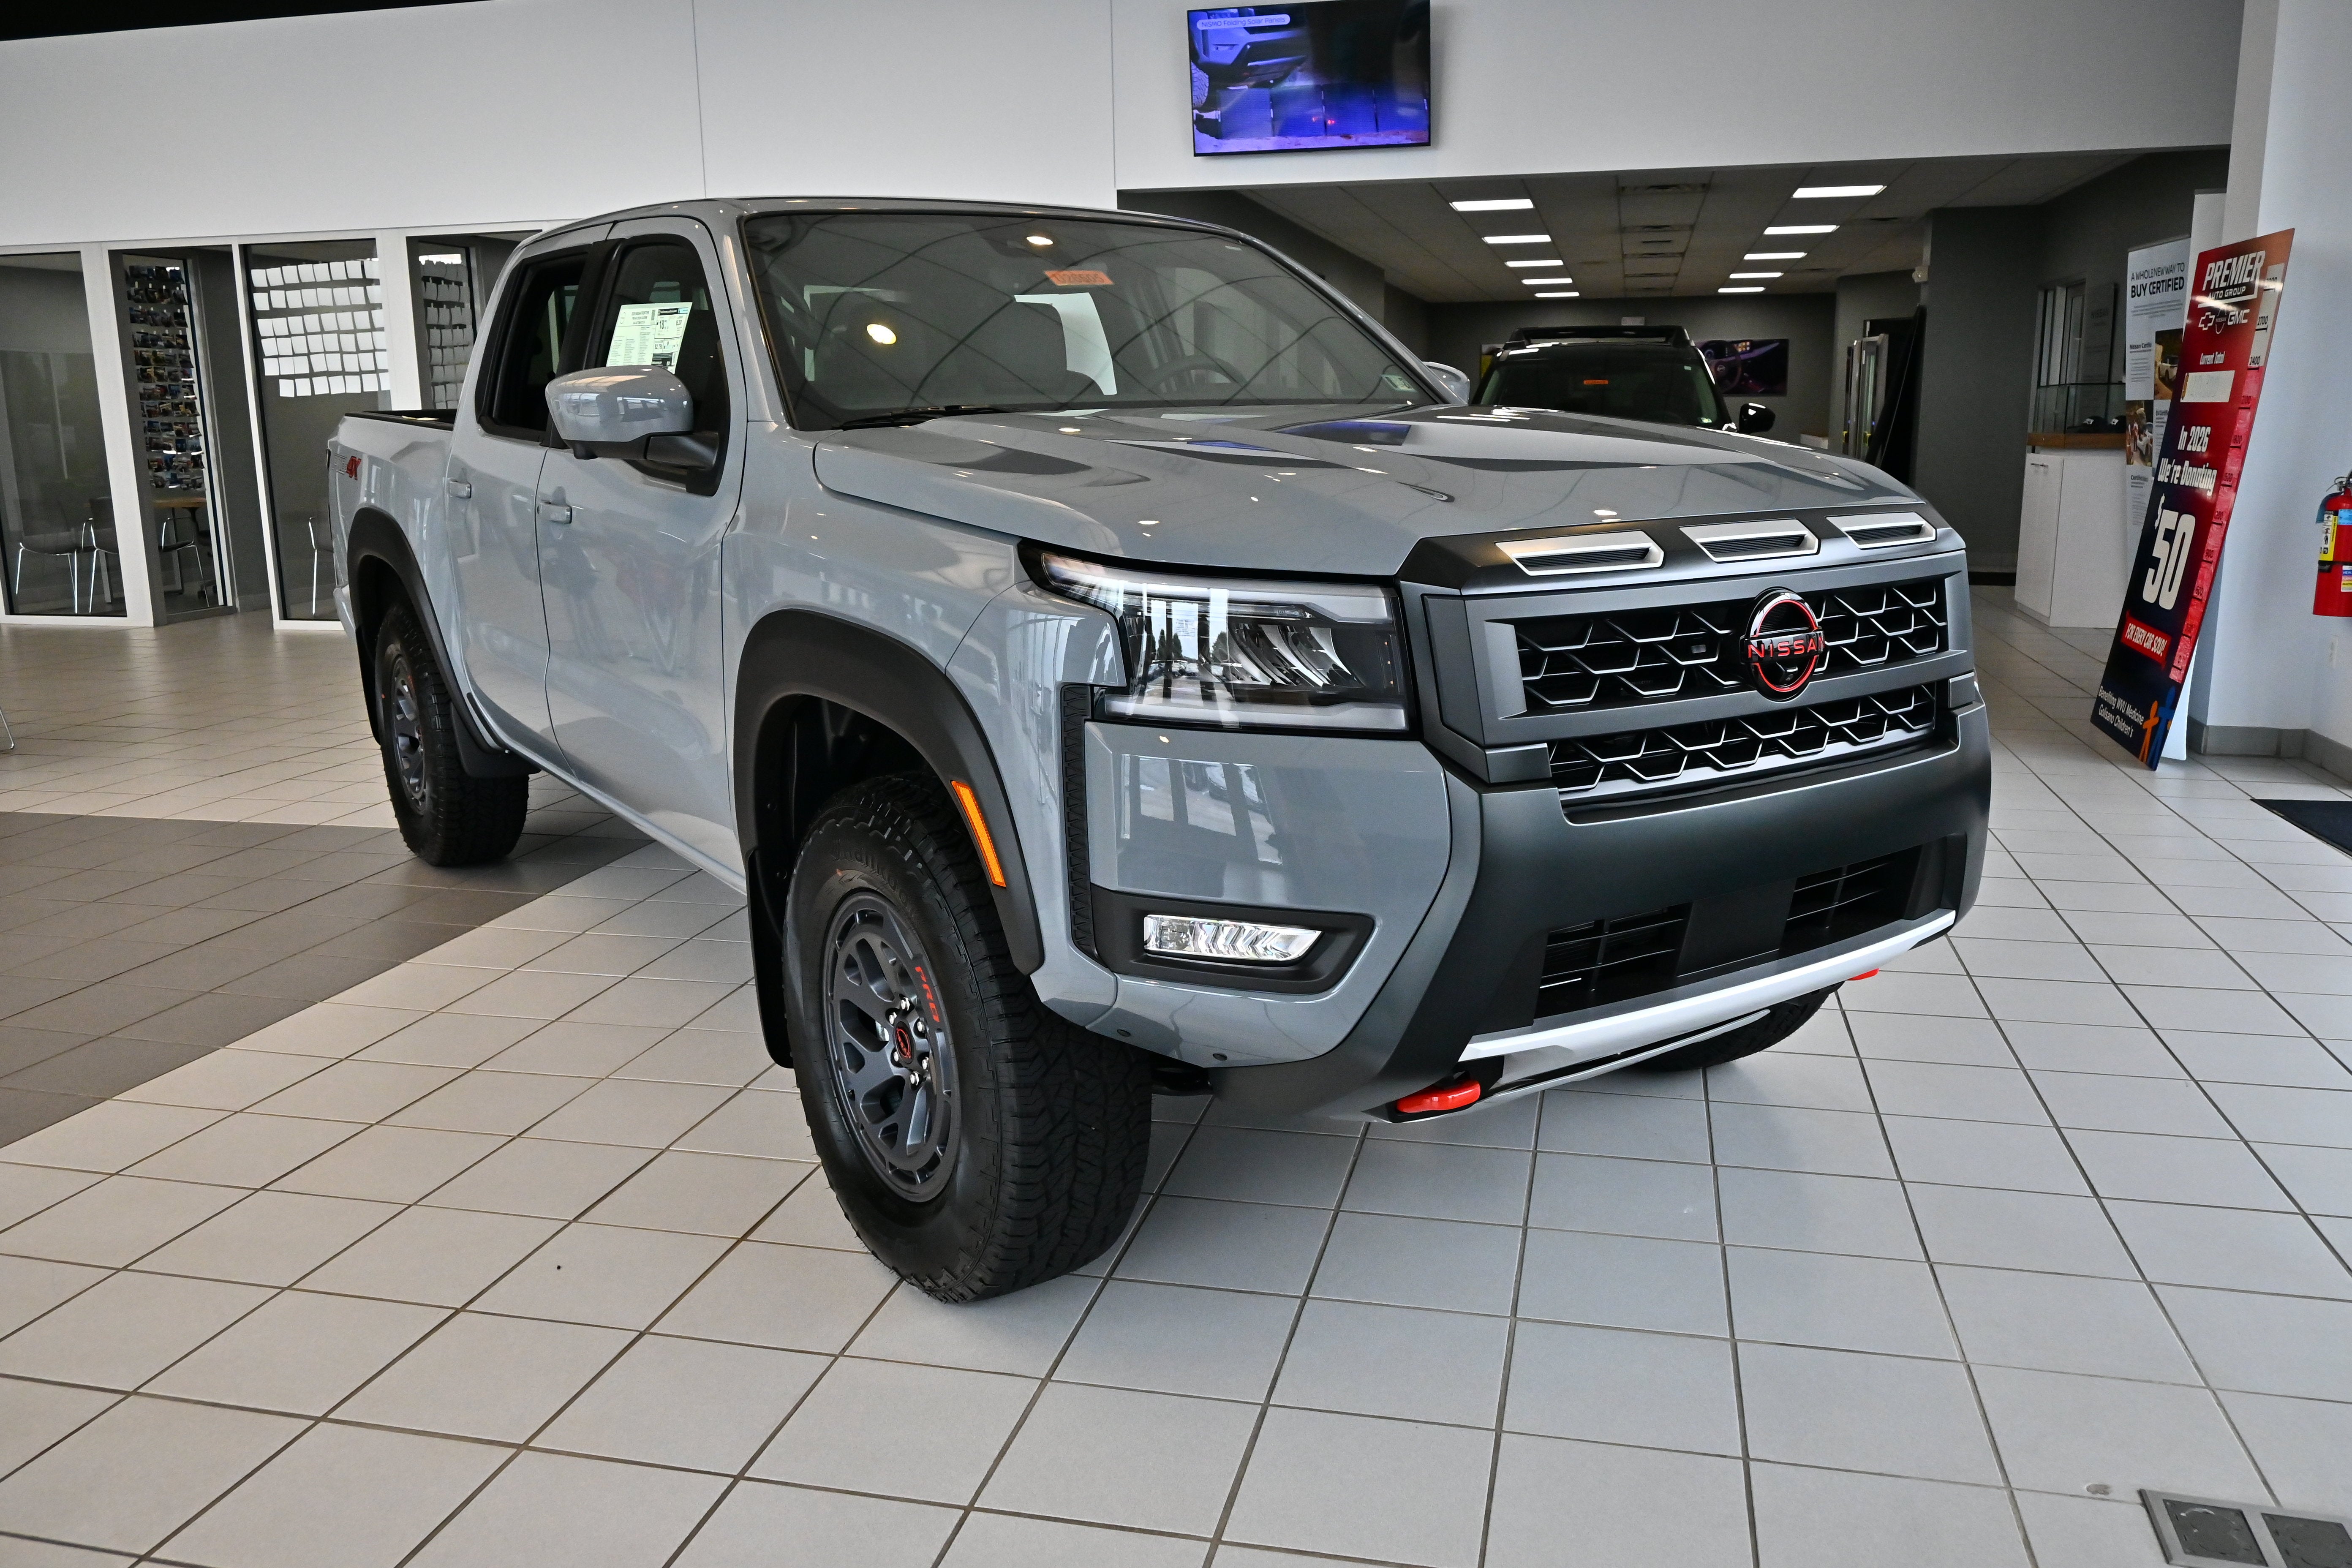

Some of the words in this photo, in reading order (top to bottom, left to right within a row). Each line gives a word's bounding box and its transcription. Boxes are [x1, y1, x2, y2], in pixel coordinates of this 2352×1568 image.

[2131, 273, 2135, 281] A
[2136, 269, 2153, 281] WHOLE
[2154, 266, 2164, 277] NEW
[2165, 264, 2176, 275] WAY
[2177, 262, 2185, 272] TO
[2202, 250, 2266, 291] PREMIER
[2131, 283, 2148, 298] BUY
[2149, 277, 2185, 295] CERTIFIED
[2208, 290, 2224, 300] AUTO
[2224, 286, 2246, 297] GROUP
[2227, 309, 2250, 325] GMC
[2257, 316, 2268, 326] 2700
[2200, 353, 2215, 365] Current
[2214, 351, 2226, 364] Total
[2249, 356, 2260, 366] 2400
[2178, 425, 2188, 450] In
[2187, 426, 2211, 452] 2026
[2158, 458, 2181, 485] We're
[2180, 460, 2217, 496] Donating
[1748, 636, 1826, 659] NISSAN
[2125, 623, 2136, 640] FOR
[2132, 626, 2147, 645] EVERY
[2143, 632, 2155, 650] CAR
[2151, 636, 2167, 657] SOLD!
[2099, 704, 2115, 724] Golisano
[2114, 715, 2134, 738] Children's
[2116, 697, 2127, 713] WVU
[2126, 703, 2144, 725] Medicine
[915, 966, 940, 1023] PRO
